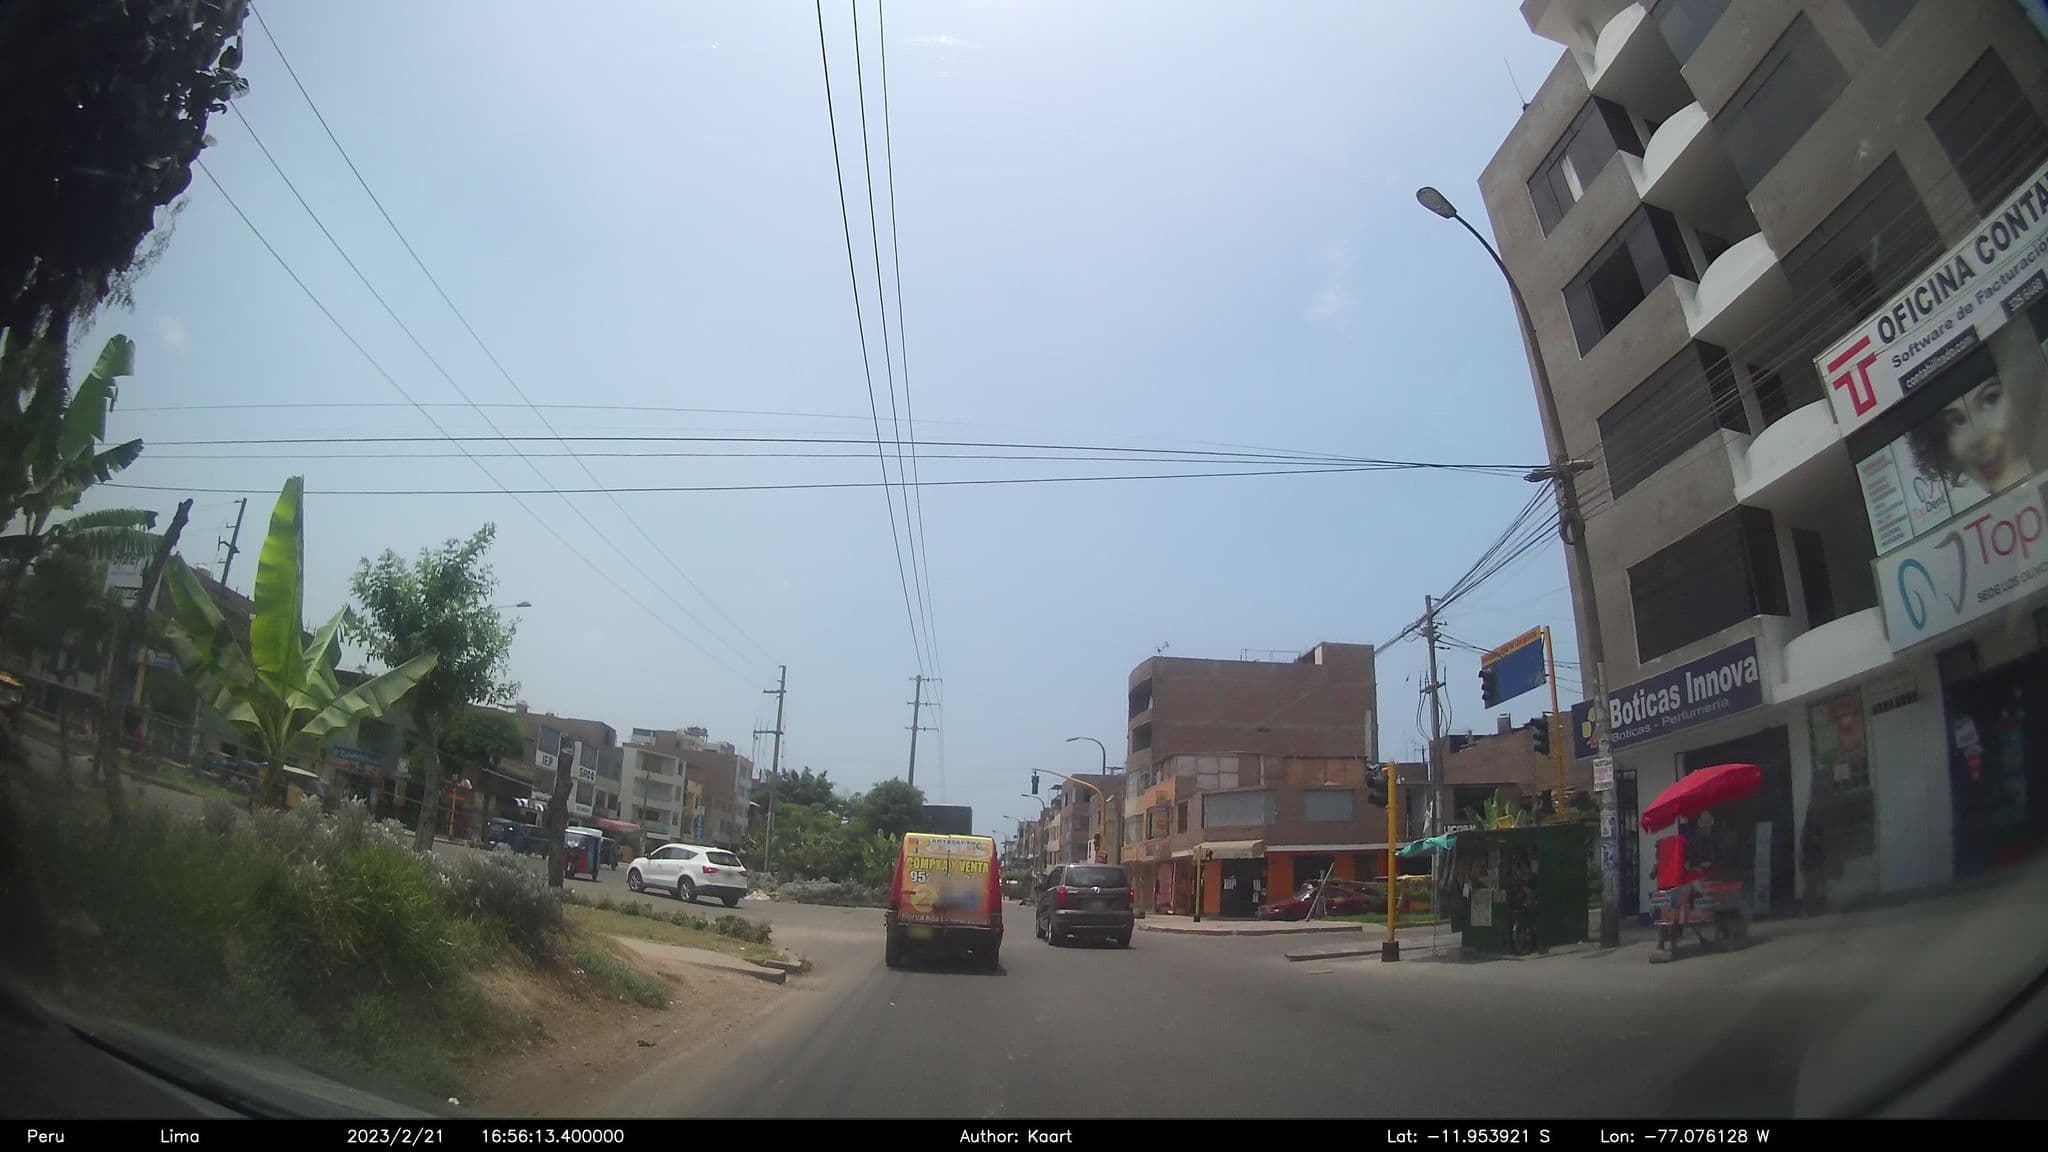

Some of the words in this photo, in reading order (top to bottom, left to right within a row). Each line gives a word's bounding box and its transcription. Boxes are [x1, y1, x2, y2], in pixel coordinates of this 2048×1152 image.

[1877, 254, 1976, 345] OFICINA
[1975, 168, 2048, 266] CONTA
[1892, 318, 1954, 368] Software
[1956, 301, 1973, 321] de
[1975, 236, 2048, 305] Facturacio
[1963, 505, 2042, 565] Top
[1609, 684, 1680, 729] Boticas
[1686, 655, 1759, 703] Innova
[1611, 723, 1652, 743] Boticas
[907, 856, 947, 872] COMPRA
[958, 860, 989, 873] VENTA
